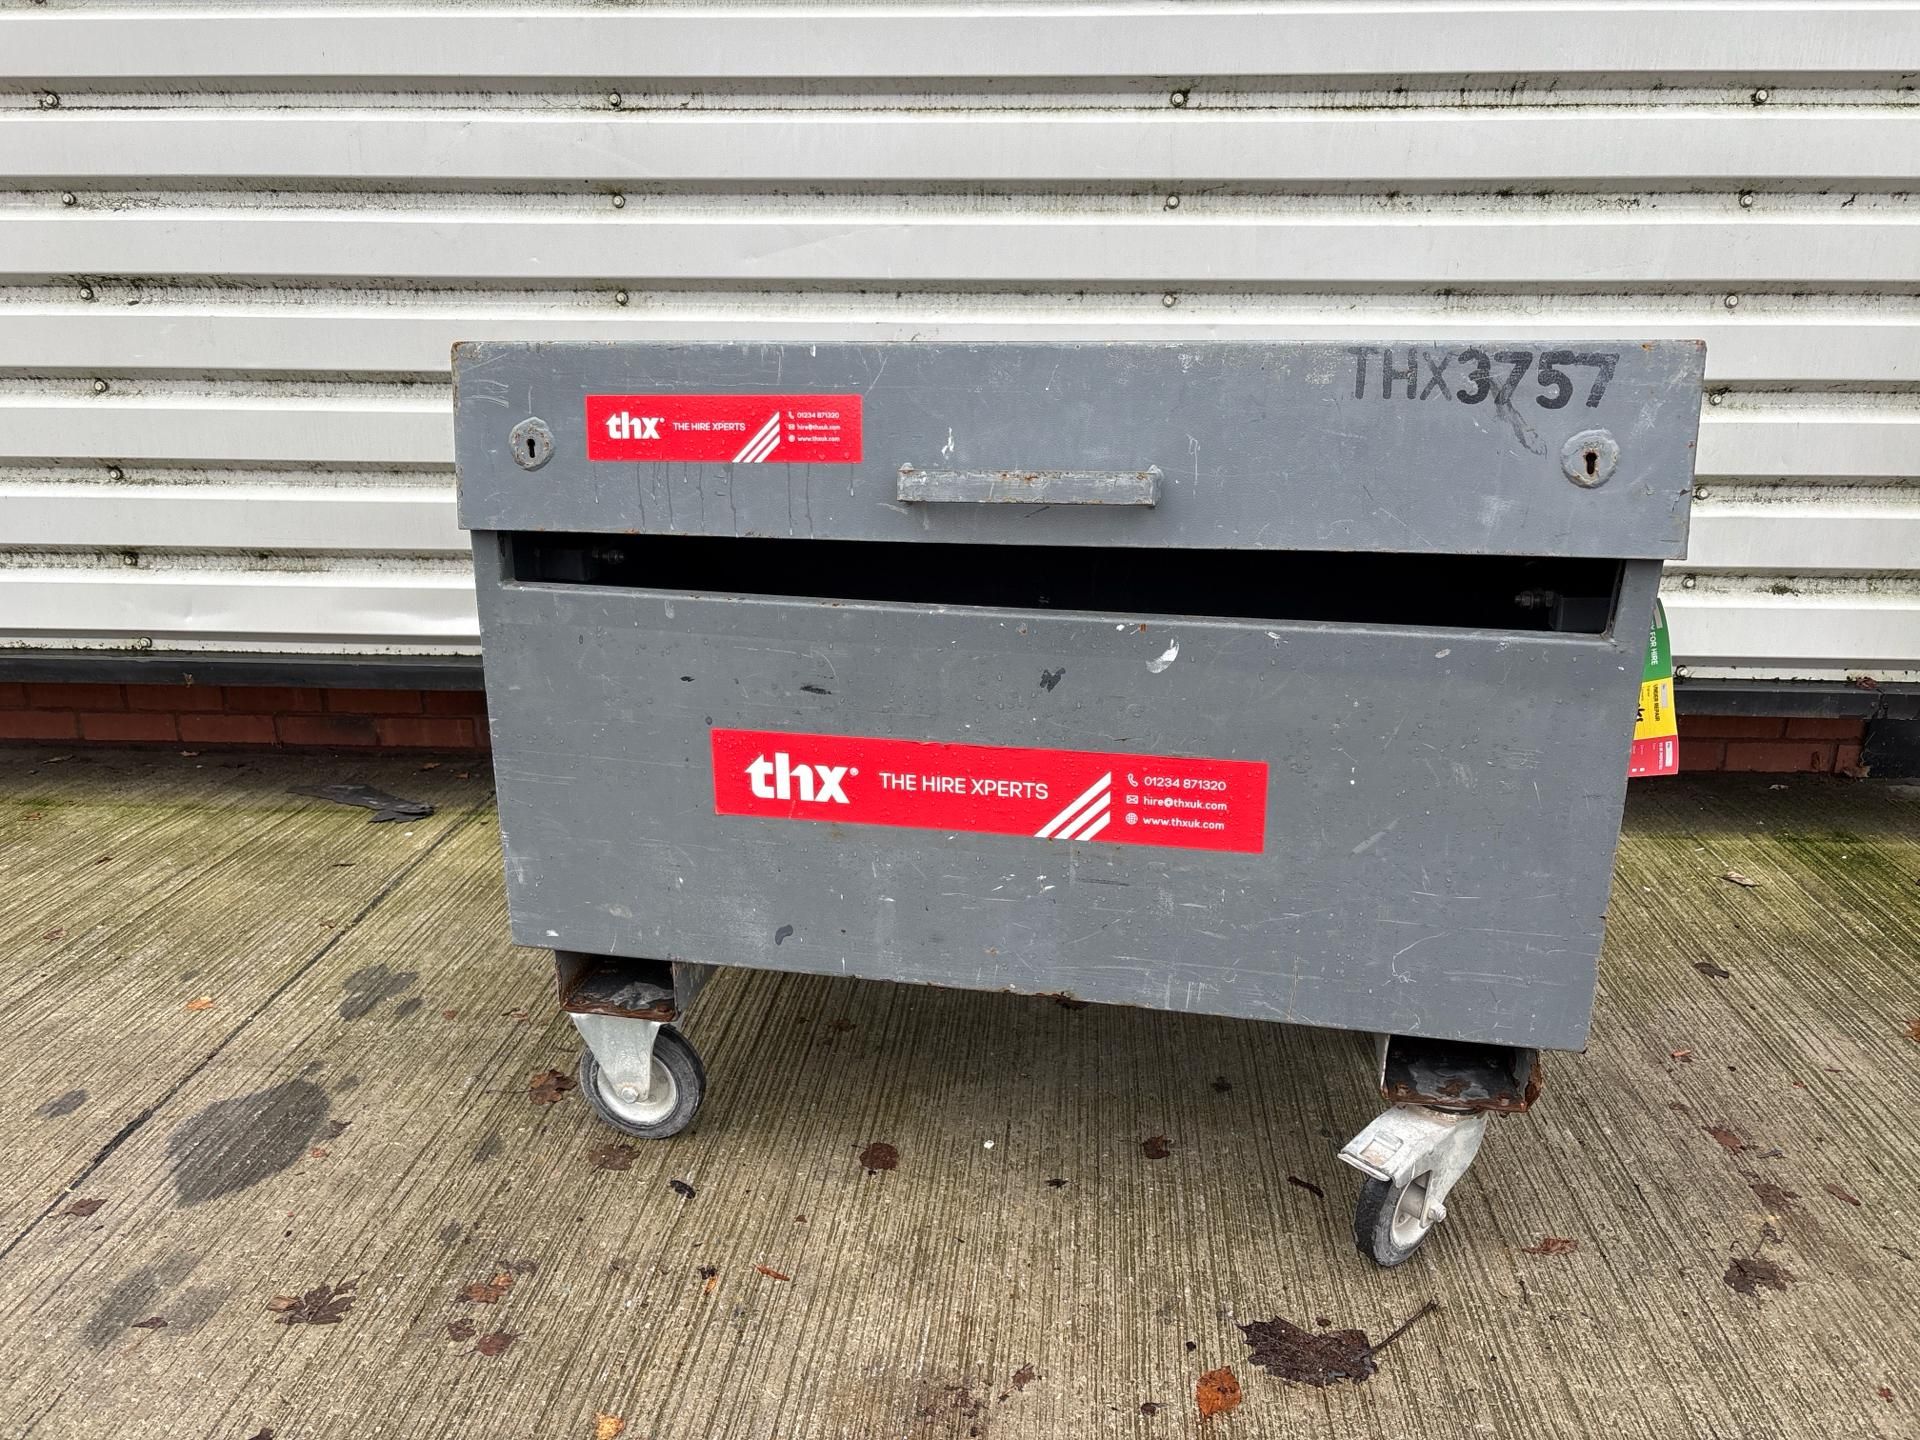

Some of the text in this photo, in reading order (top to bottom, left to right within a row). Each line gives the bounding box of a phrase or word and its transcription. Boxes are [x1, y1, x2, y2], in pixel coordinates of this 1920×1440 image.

[1348, 346, 1620, 409] THX3757
[797, 411, 815, 419] 01234
[672, 422, 746, 432] THE HIRE XPERTS
[1650, 648, 1659, 666] HIRE
[878, 772, 1048, 800] THE HIRE XPERTS
[1144, 775, 1227, 791] 01234 871320
[1143, 795, 1228, 812] hire@thxuk.com
[1143, 815, 1225, 831] www.thxuk.com
